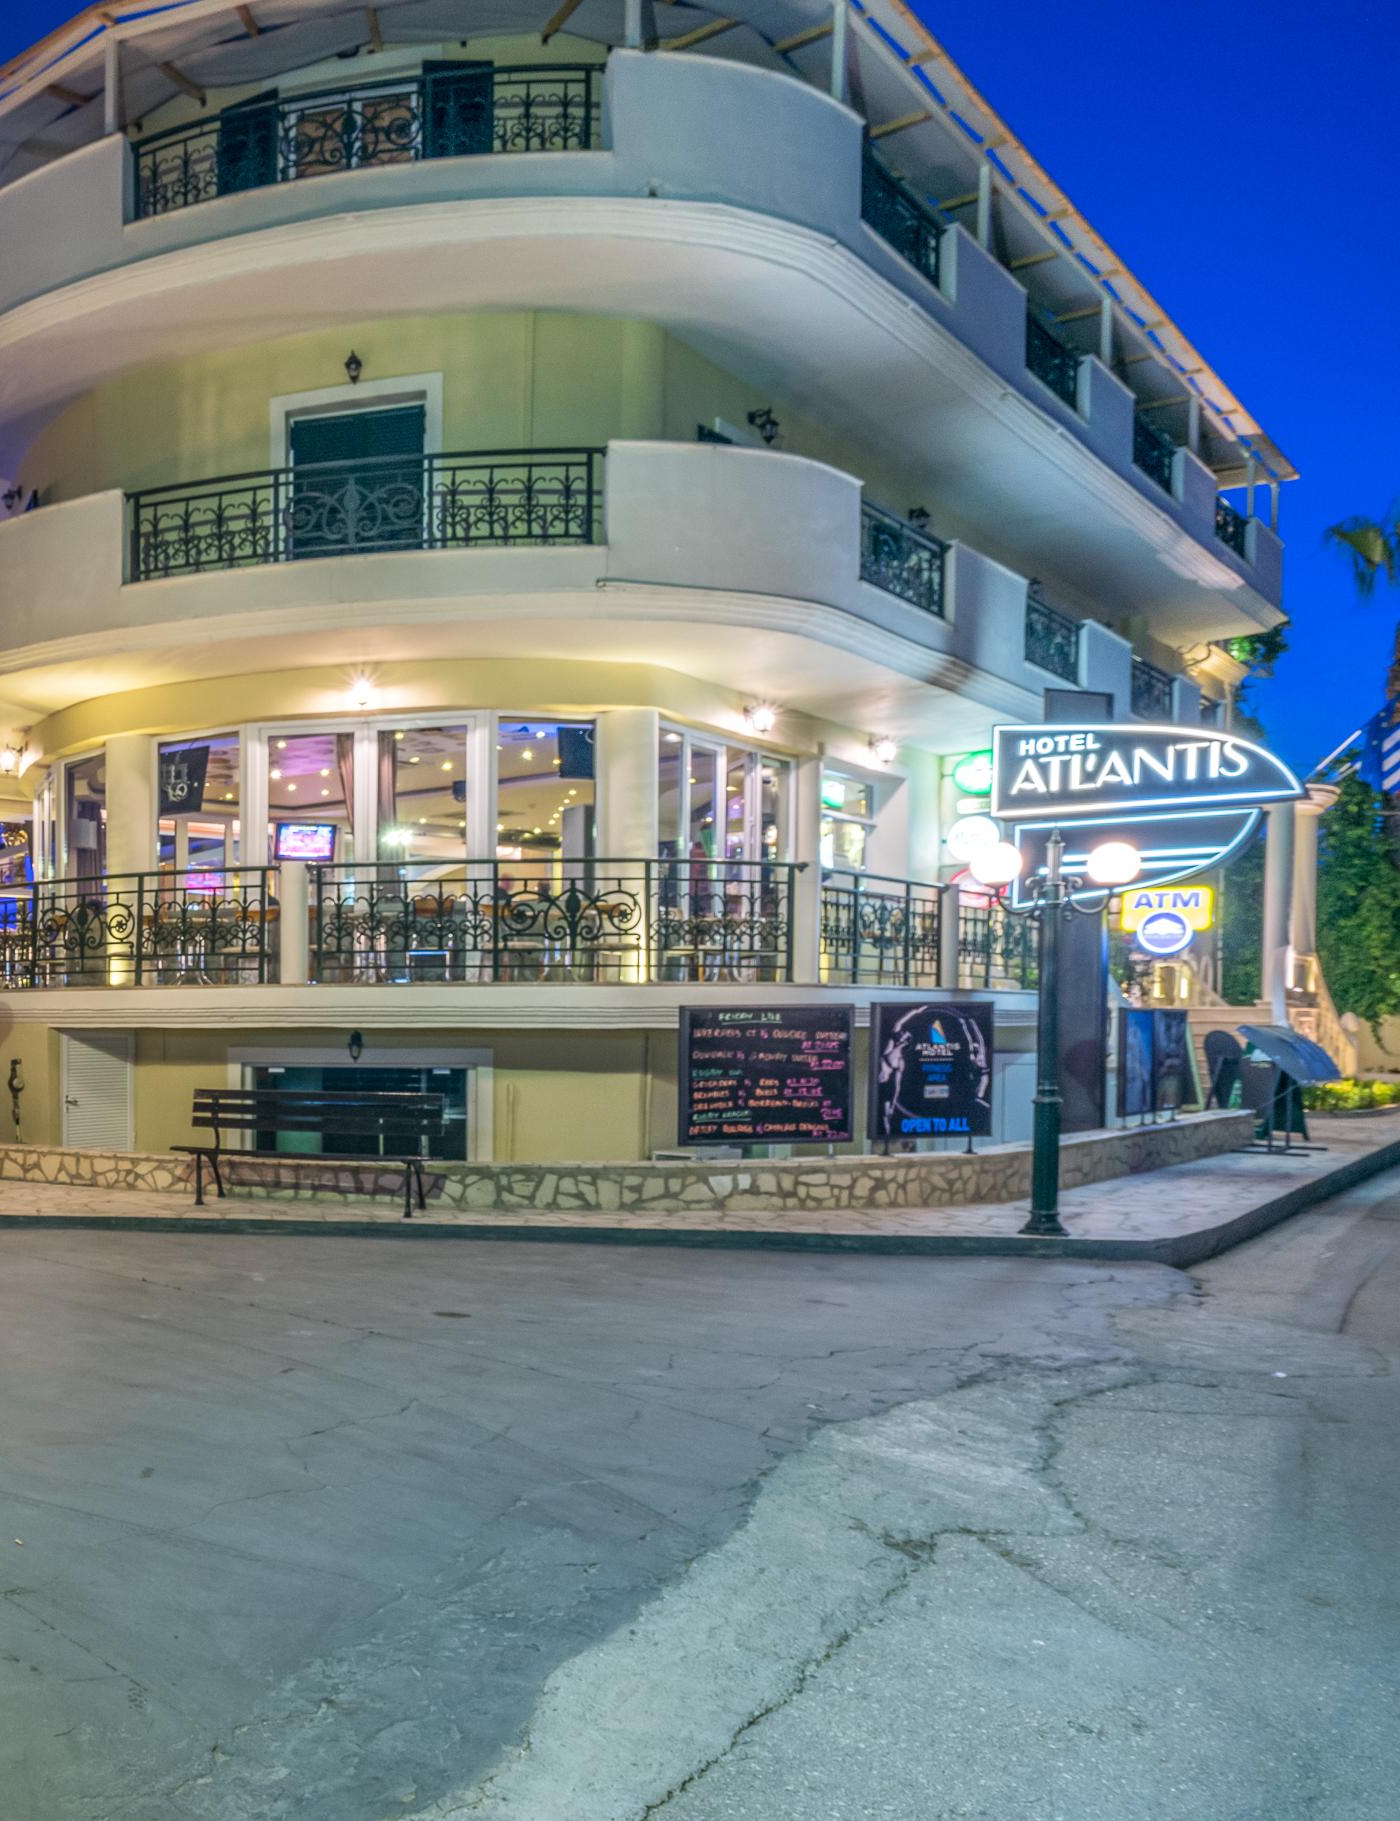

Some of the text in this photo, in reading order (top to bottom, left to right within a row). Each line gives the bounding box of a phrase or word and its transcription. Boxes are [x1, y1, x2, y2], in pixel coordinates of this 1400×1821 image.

[1019, 733, 1100, 756] HOTEL
[1134, 892, 1200, 909] ATM
[902, 1117, 970, 1133] OPEN TO ALL
